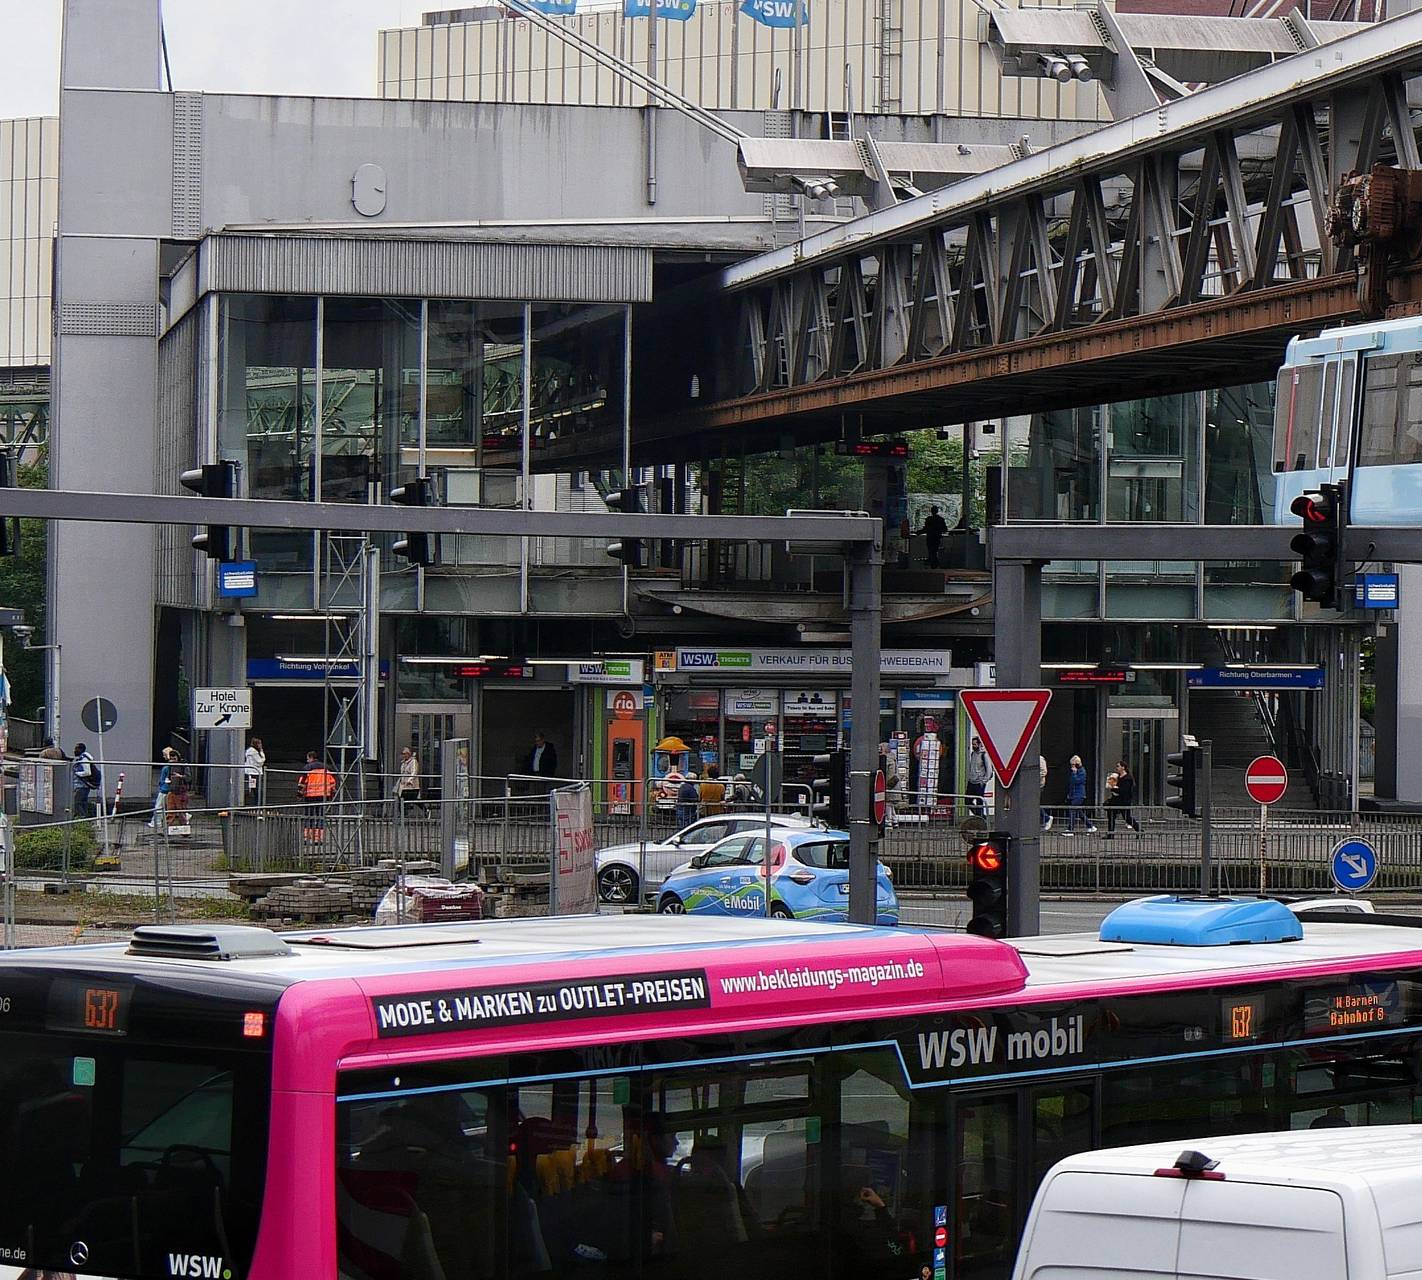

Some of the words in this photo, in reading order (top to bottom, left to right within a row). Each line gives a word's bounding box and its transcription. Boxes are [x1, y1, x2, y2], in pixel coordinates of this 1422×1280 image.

[279, 662, 312, 671] Richtung
[759, 655, 806, 665] VERKAUF
[809, 654, 829, 665] FÜR
[831, 655, 853, 665] BUS
[879, 656, 943, 667] HWEBEBAHN
[1219, 671, 1249, 680] Richtung
[210, 691, 237, 702] Hotel
[196, 703, 214, 713] Zur
[219, 703, 250, 713] Krone
[724, 894, 760, 911] eMobil
[720, 958, 924, 994] www.bekleidungs-magazin.de
[84, 988, 120, 1029] 637
[377, 1001, 435, 1029] MODE
[438, 1000, 453, 1023] &
[454, 991, 533, 1021] MARKEN
[536, 994, 558, 1014] zu
[559, 976, 705, 1011] OUTLET-PREISEN
[1231, 1005, 1251, 1039] 637
[1330, 1009, 1374, 1027] Bahnhof
[918, 1024, 997, 1070] WSW
[1007, 1014, 1084, 1061] mobil
